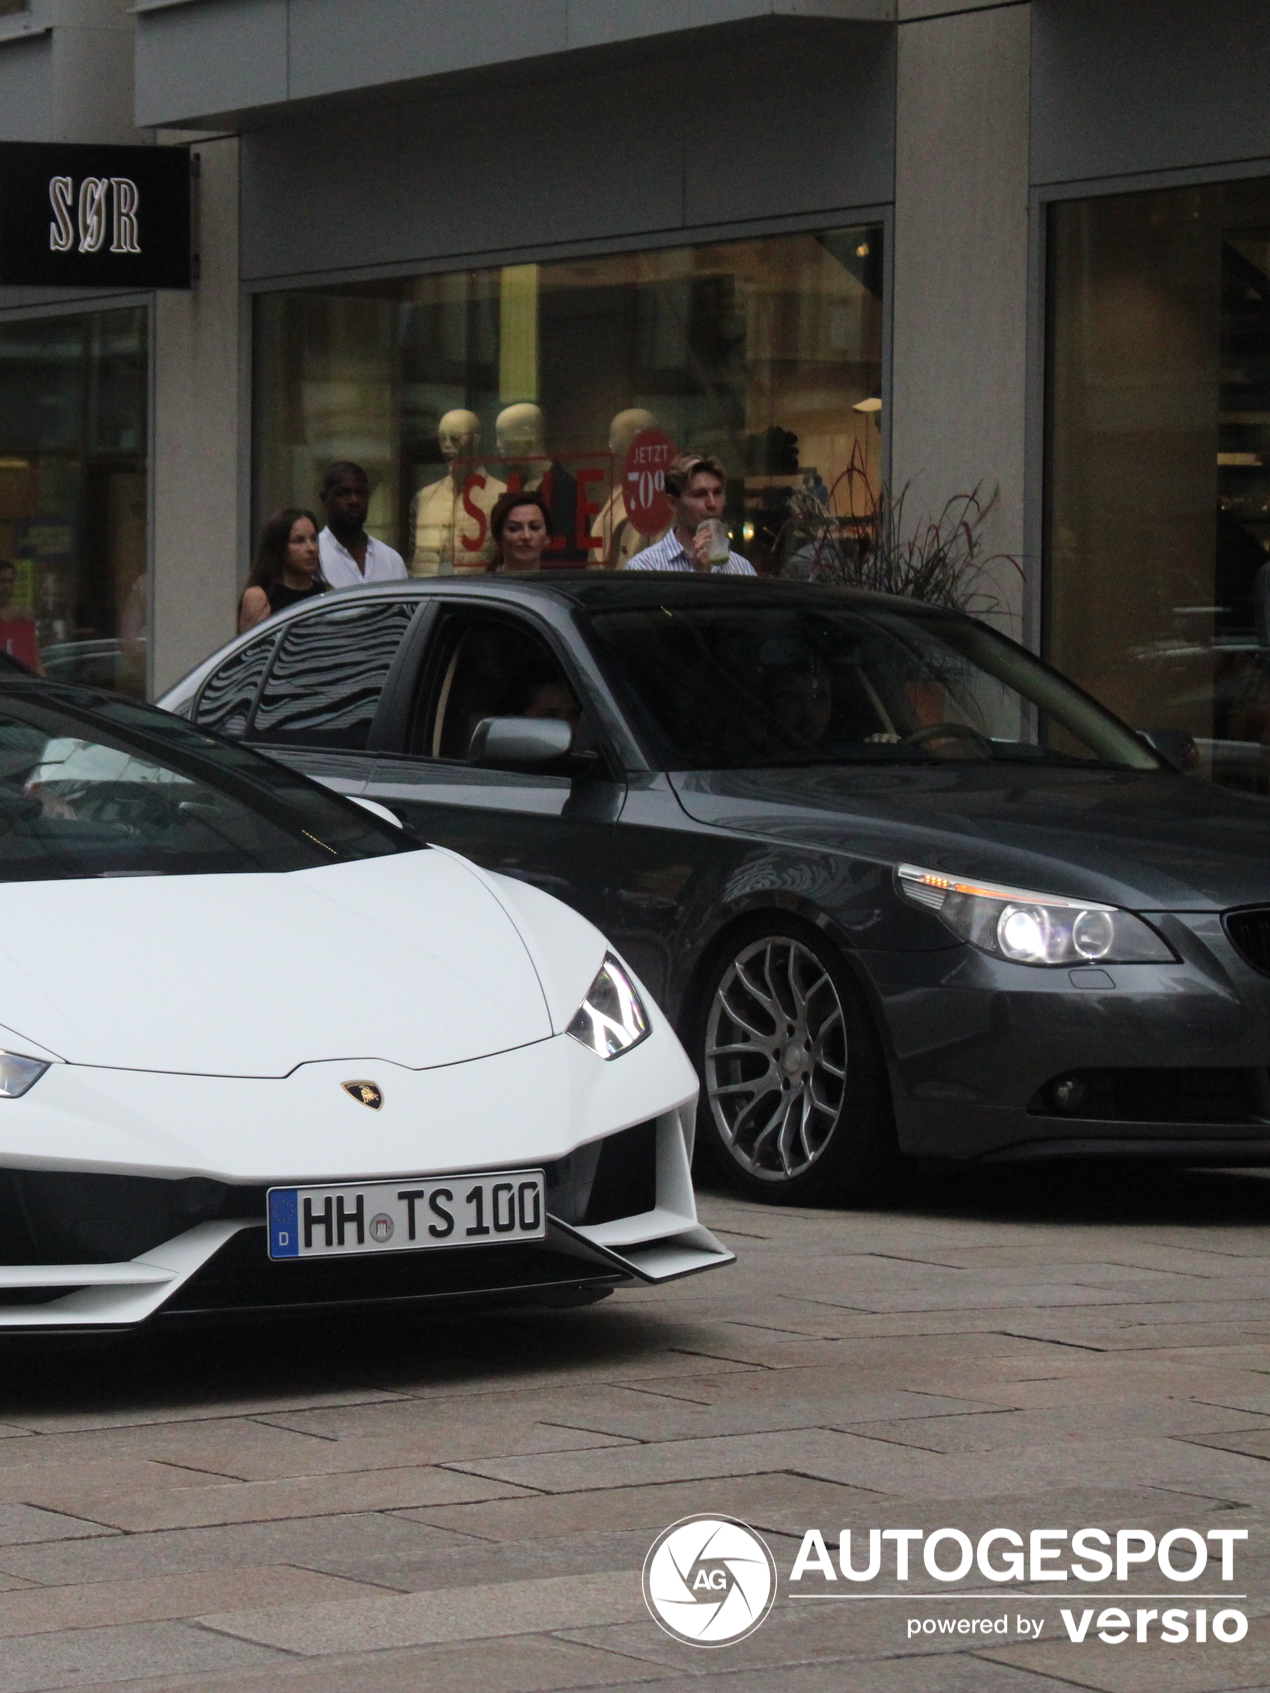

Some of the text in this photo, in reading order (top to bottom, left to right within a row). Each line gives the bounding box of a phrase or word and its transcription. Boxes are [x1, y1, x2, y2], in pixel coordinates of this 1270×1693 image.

[49, 176, 141, 253] SØR
[633, 445, 669, 464] JETZT
[461, 468, 604, 551] SLE
[279, 1231, 289, 1246] D
[303, 1193, 365, 1248] HH
